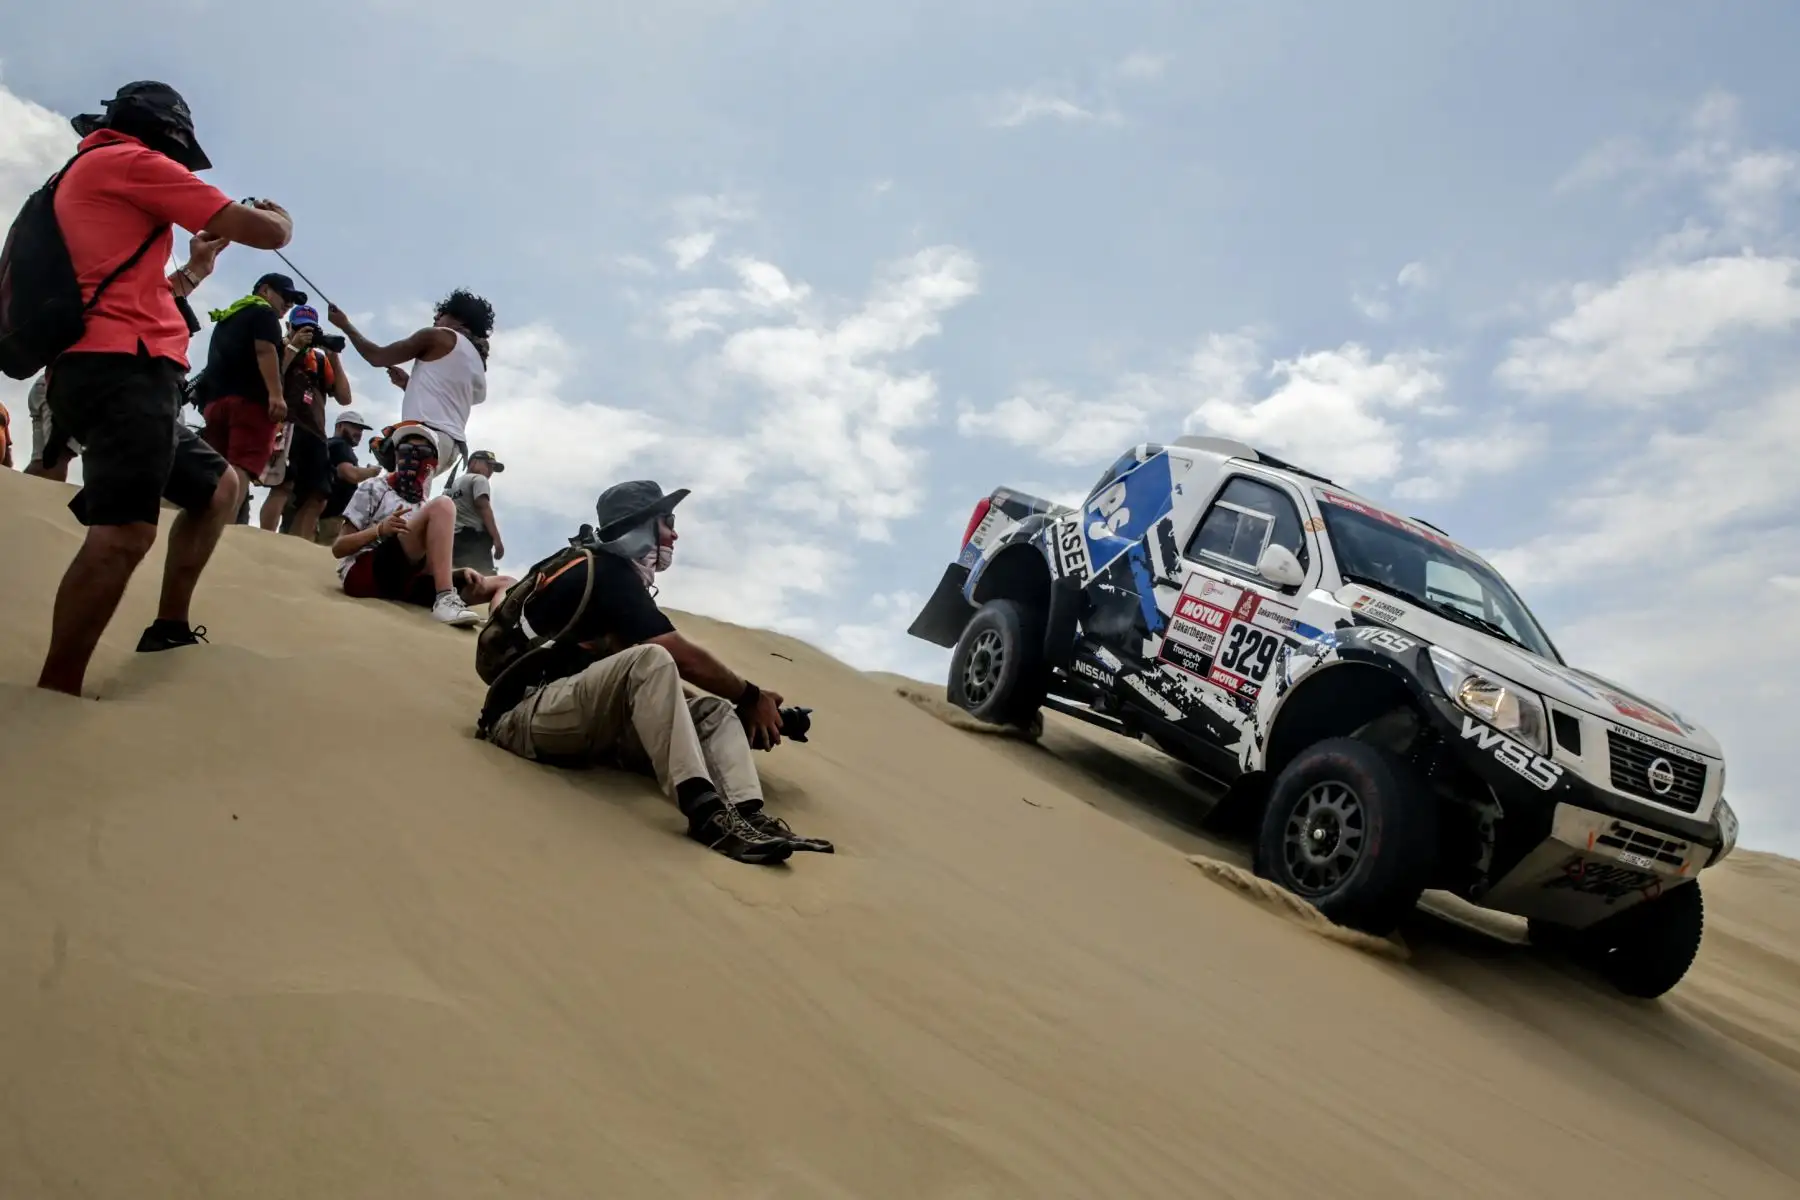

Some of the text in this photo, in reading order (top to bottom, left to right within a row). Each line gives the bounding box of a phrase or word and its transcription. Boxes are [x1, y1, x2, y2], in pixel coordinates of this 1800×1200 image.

[1088, 482, 1130, 540] PS
[1180, 599, 1225, 628] MOTUL
[1172, 619, 1217, 646] Dakarthegame
[1355, 627, 1417, 653] WSS
[1182, 657, 1200, 672] sport
[1220, 623, 1279, 682] 329
[1075, 660, 1114, 687] NISSAN
[1211, 671, 1239, 689] MOTUL
[1460, 715, 1564, 791] WSS
